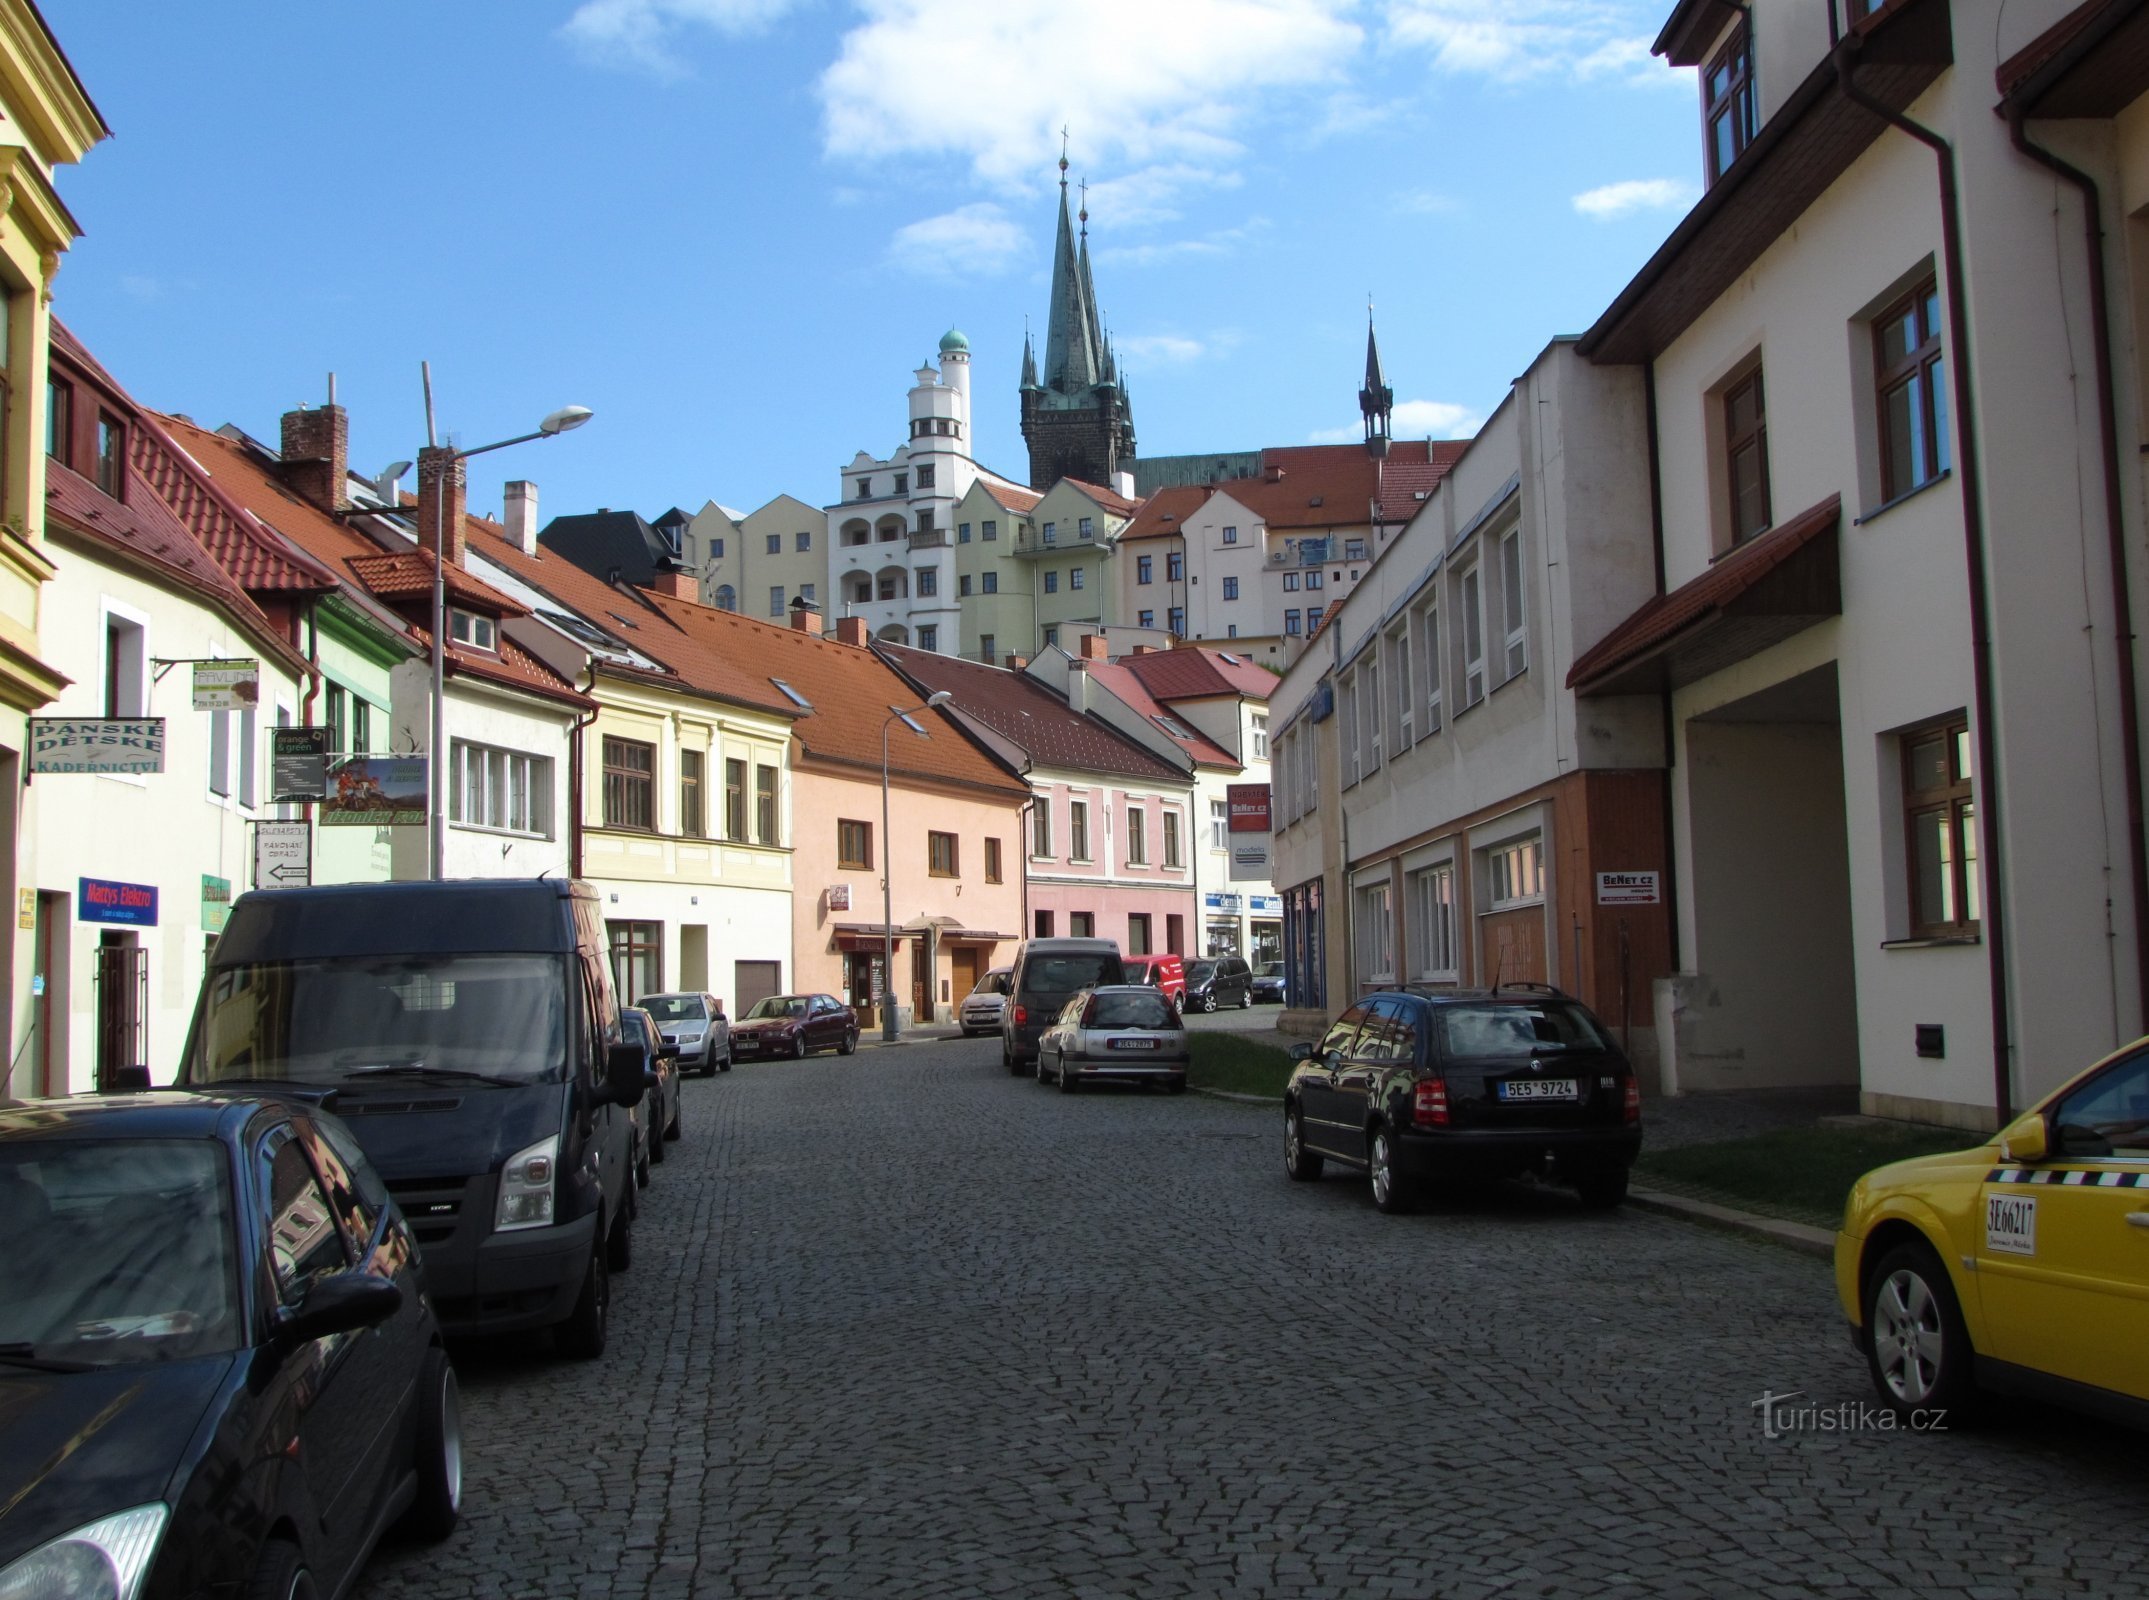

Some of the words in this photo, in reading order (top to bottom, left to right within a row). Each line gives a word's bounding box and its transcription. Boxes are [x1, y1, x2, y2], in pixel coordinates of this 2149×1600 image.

[277, 736, 309, 745] orange
[286, 744, 312, 753] green
[120, 885, 151, 907] Elektro
[1508, 1083, 1532, 1096] 5E5
[1541, 1082, 1571, 1095] 9724
[1988, 1199, 2033, 1235] 3E66217
